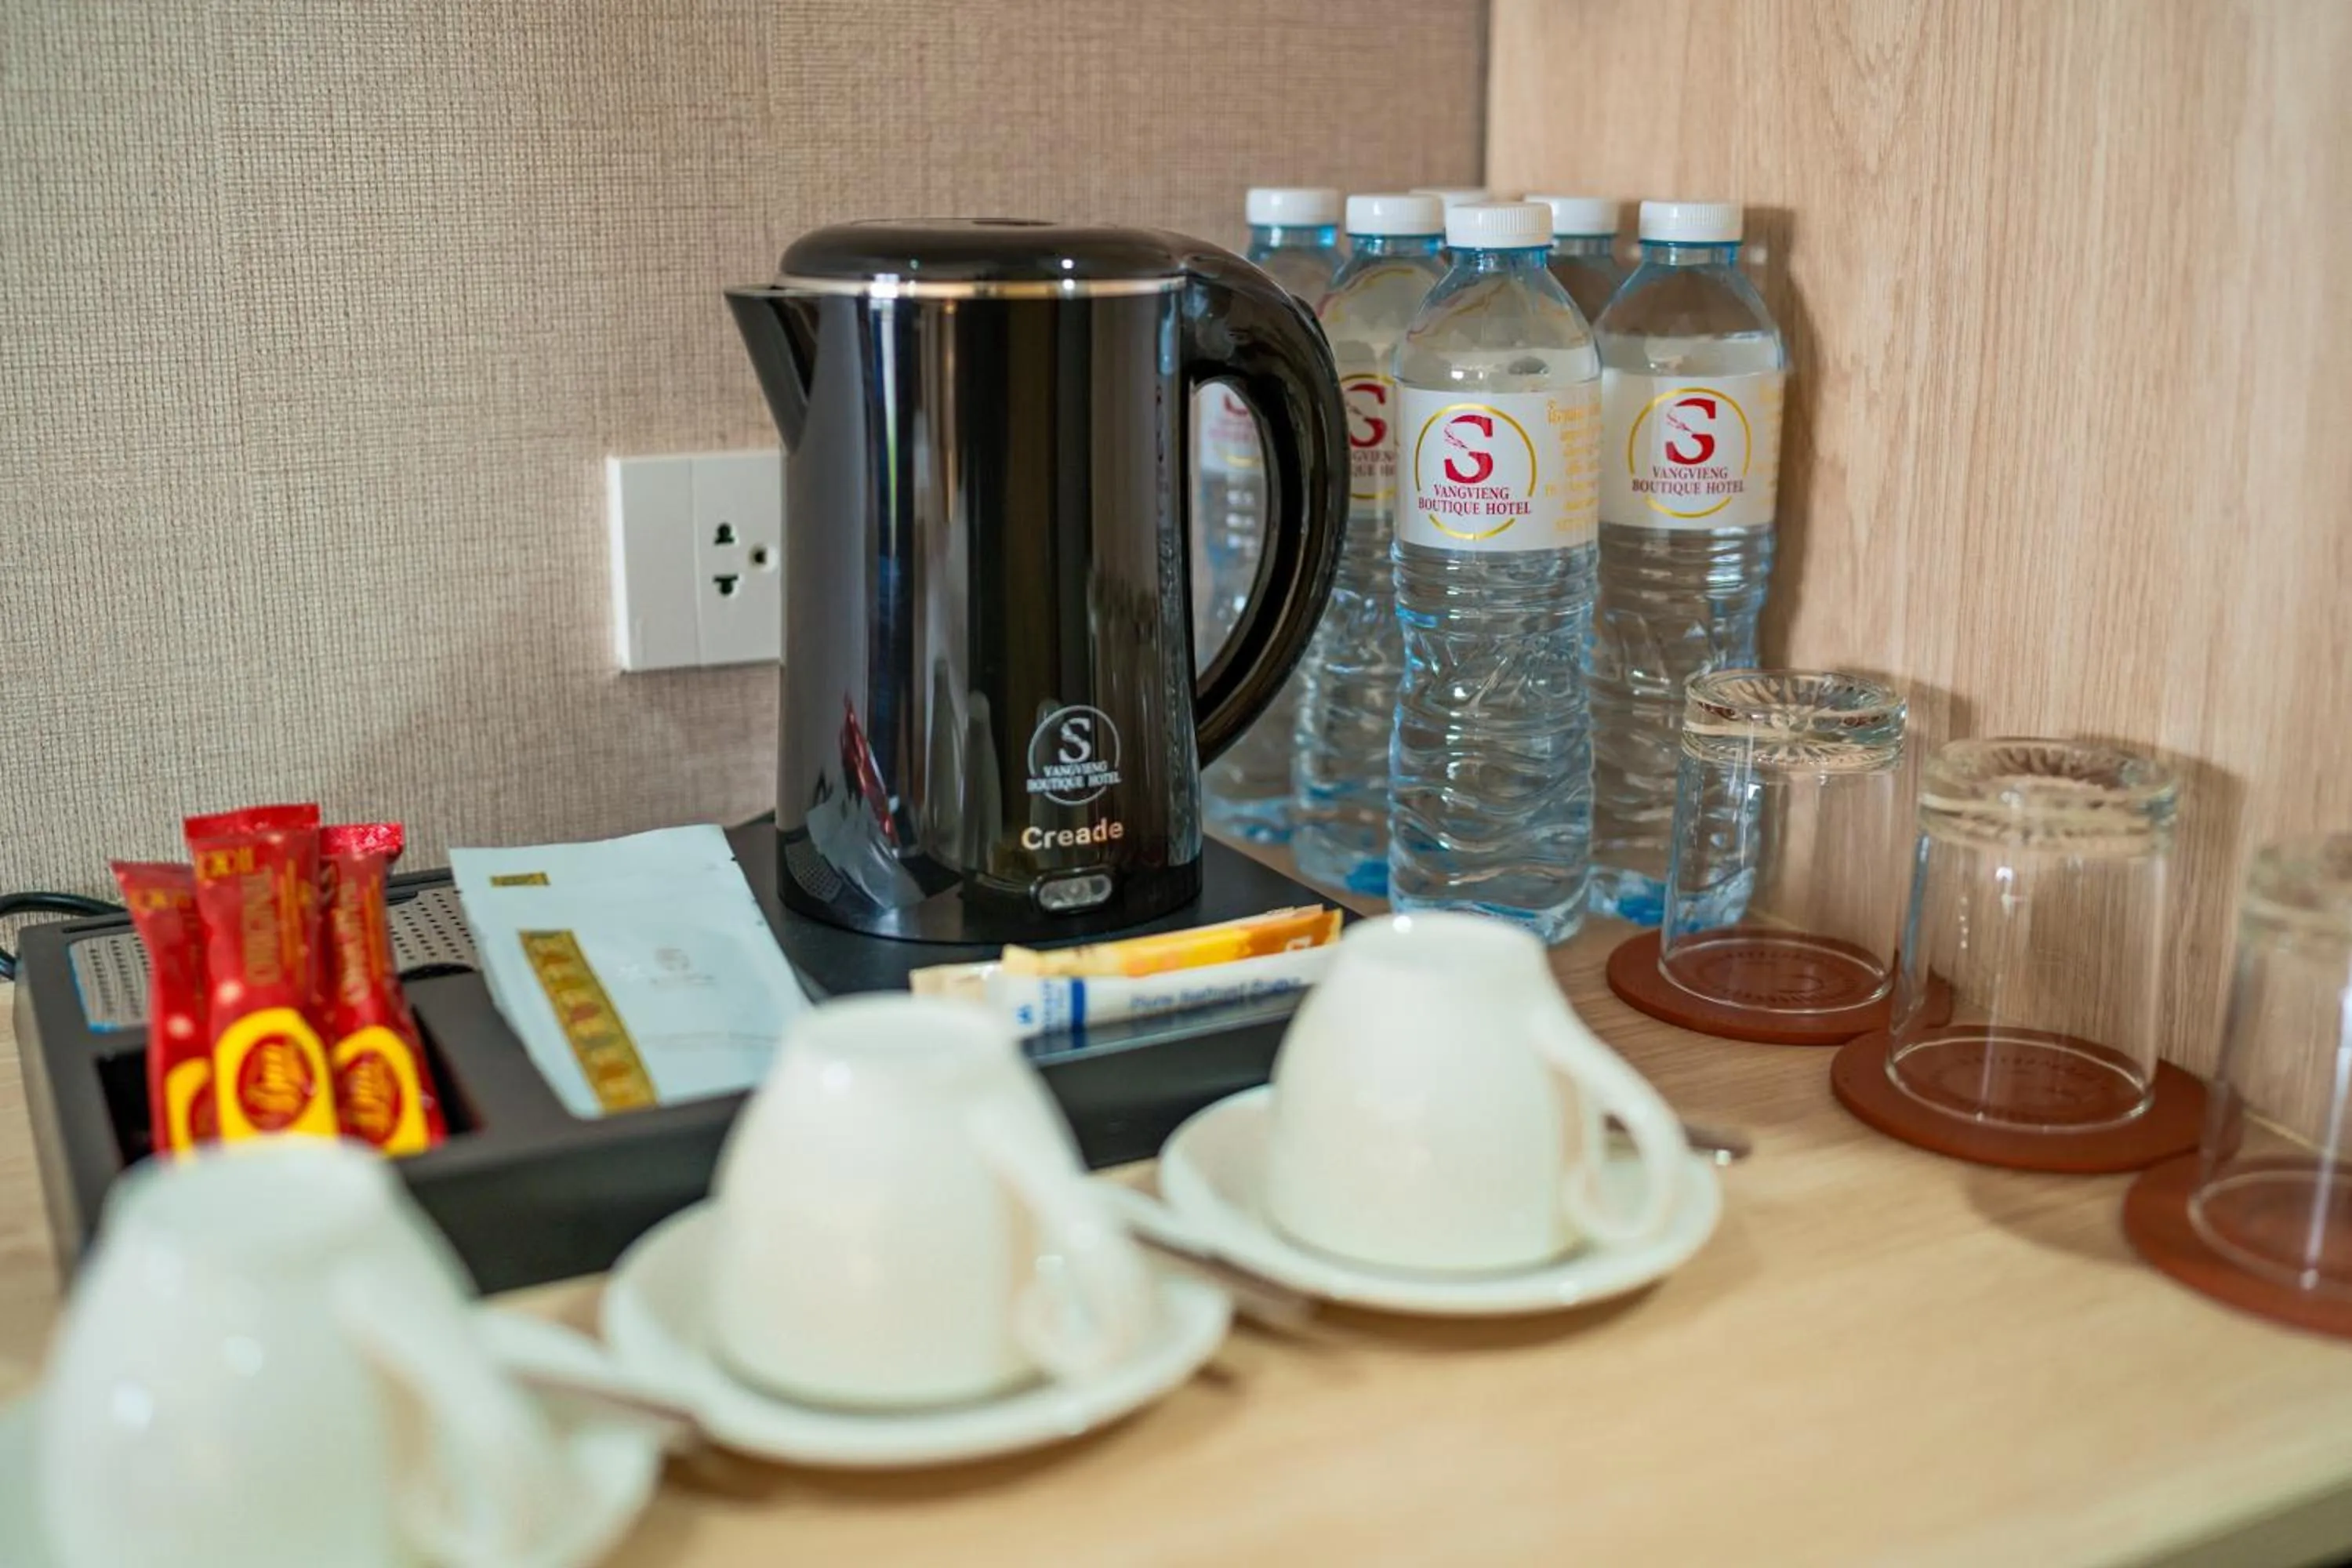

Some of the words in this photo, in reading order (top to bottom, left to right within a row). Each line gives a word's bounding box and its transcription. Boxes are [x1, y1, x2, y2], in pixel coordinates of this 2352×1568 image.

[1666, 398, 1716, 465] S
[1444, 415, 1494, 484] S
[1652, 466, 1729, 480] VANGVIENG
[1433, 483, 1510, 501] VANGVIENG
[1631, 477, 1702, 497] BOUTIQUE
[1706, 479, 1745, 495] HOTEL
[1418, 496, 1481, 517] BOUTIQUE
[1486, 501, 1532, 516] HOTEL
[1058, 717, 1092, 763] S
[1025, 775, 1086, 793] BOUTIQUE
[1087, 771, 1122, 787] HOTEL
[1022, 817, 1124, 851] Creade
